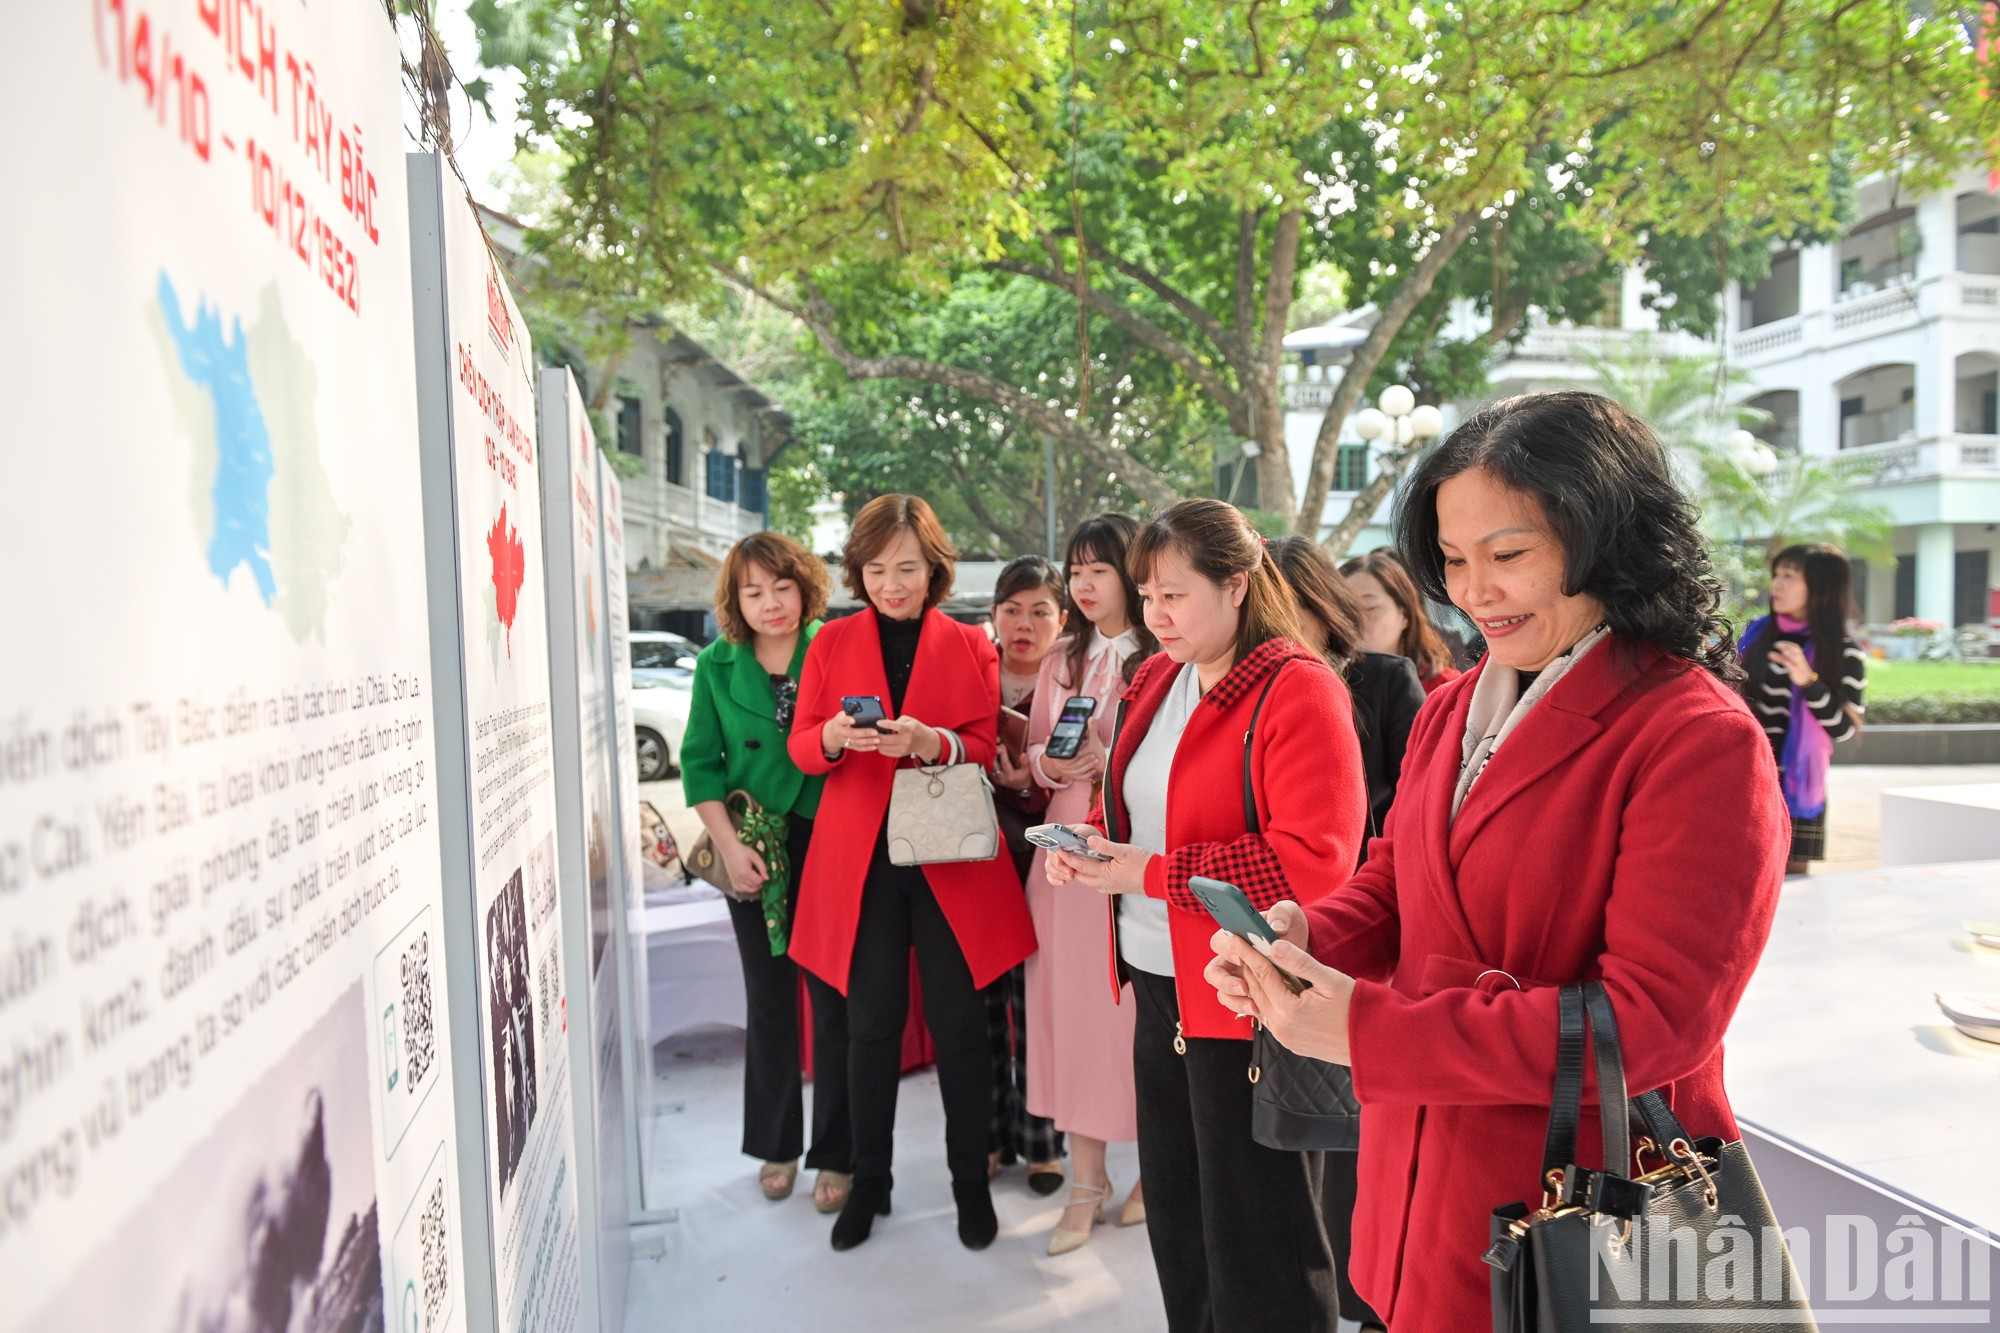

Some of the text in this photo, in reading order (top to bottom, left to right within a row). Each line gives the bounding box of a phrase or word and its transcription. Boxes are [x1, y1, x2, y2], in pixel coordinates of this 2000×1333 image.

[286, 49, 332, 185] TÂY
[339, 122, 379, 246] BẮC
[351, 678, 364, 710] Lai
